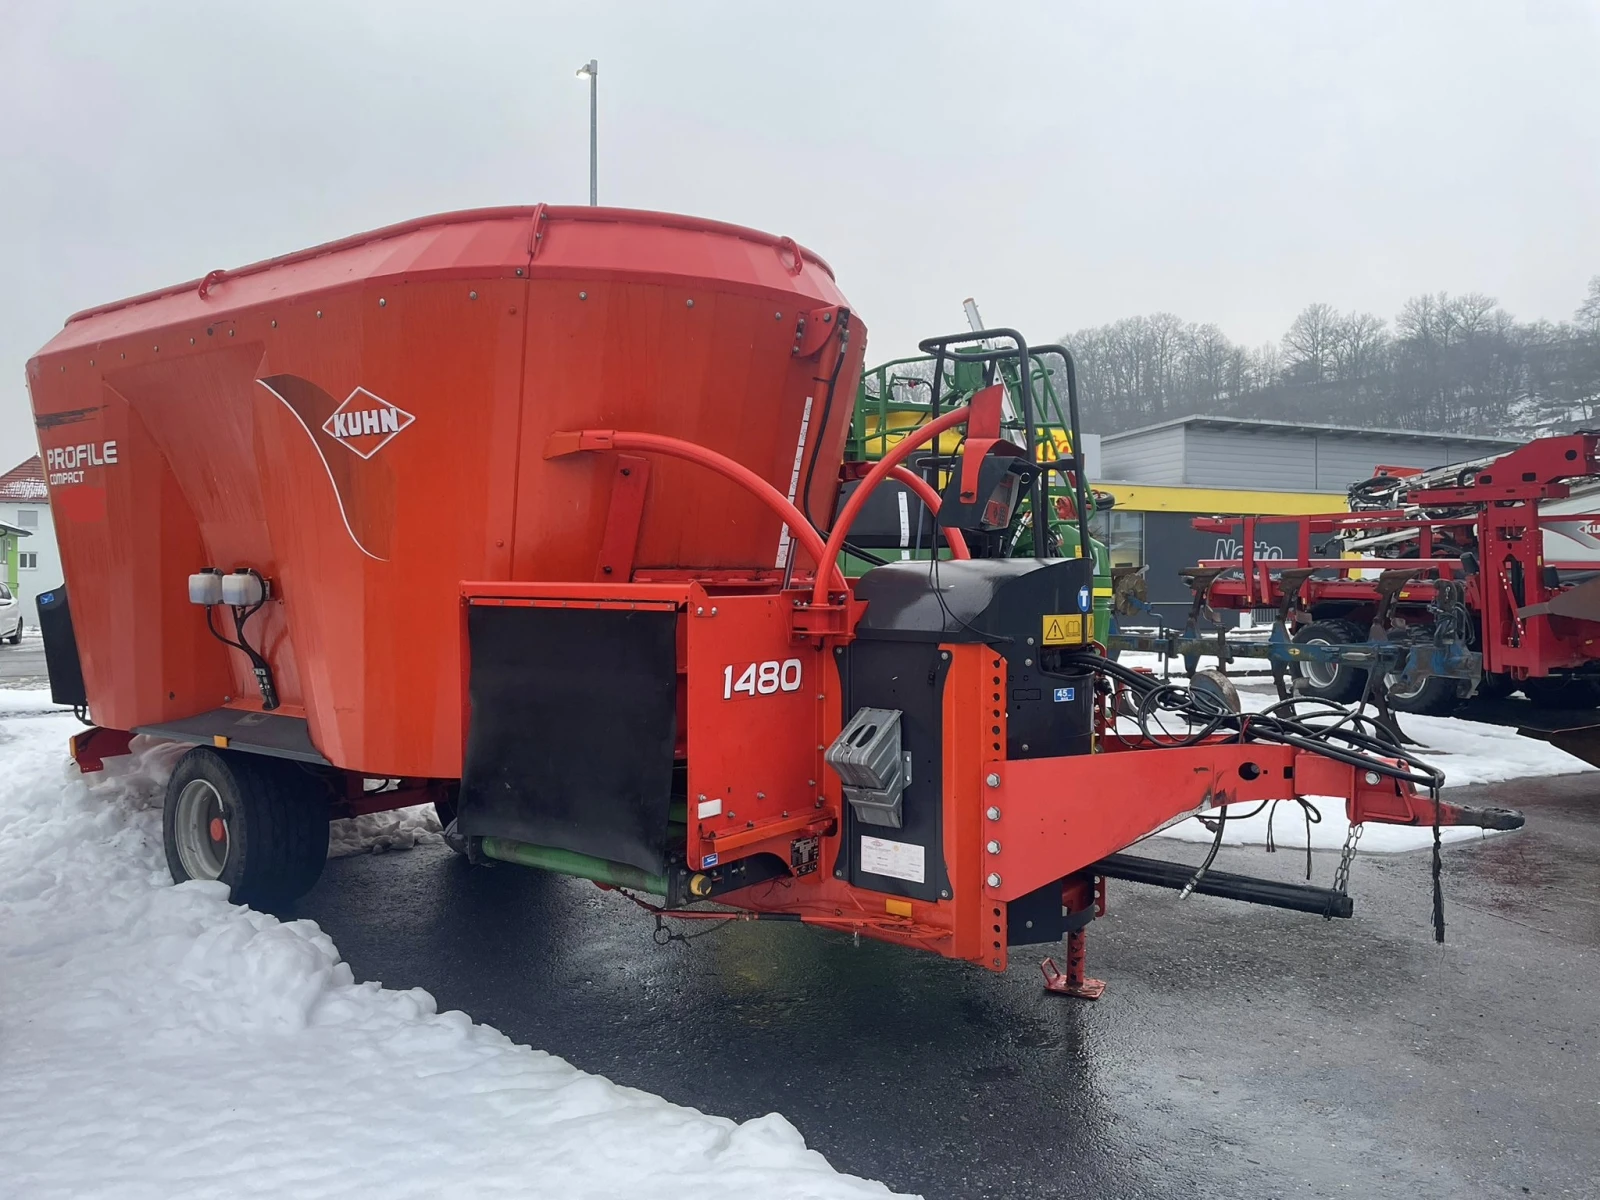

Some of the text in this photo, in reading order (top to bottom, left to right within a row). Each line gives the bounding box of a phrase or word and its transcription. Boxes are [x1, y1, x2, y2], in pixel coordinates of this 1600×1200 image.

[333, 407, 399, 438] KUHN
[46, 440, 118, 471] PROFILE
[49, 470, 85, 485] COMPACT
[722, 658, 802, 700] 1480
